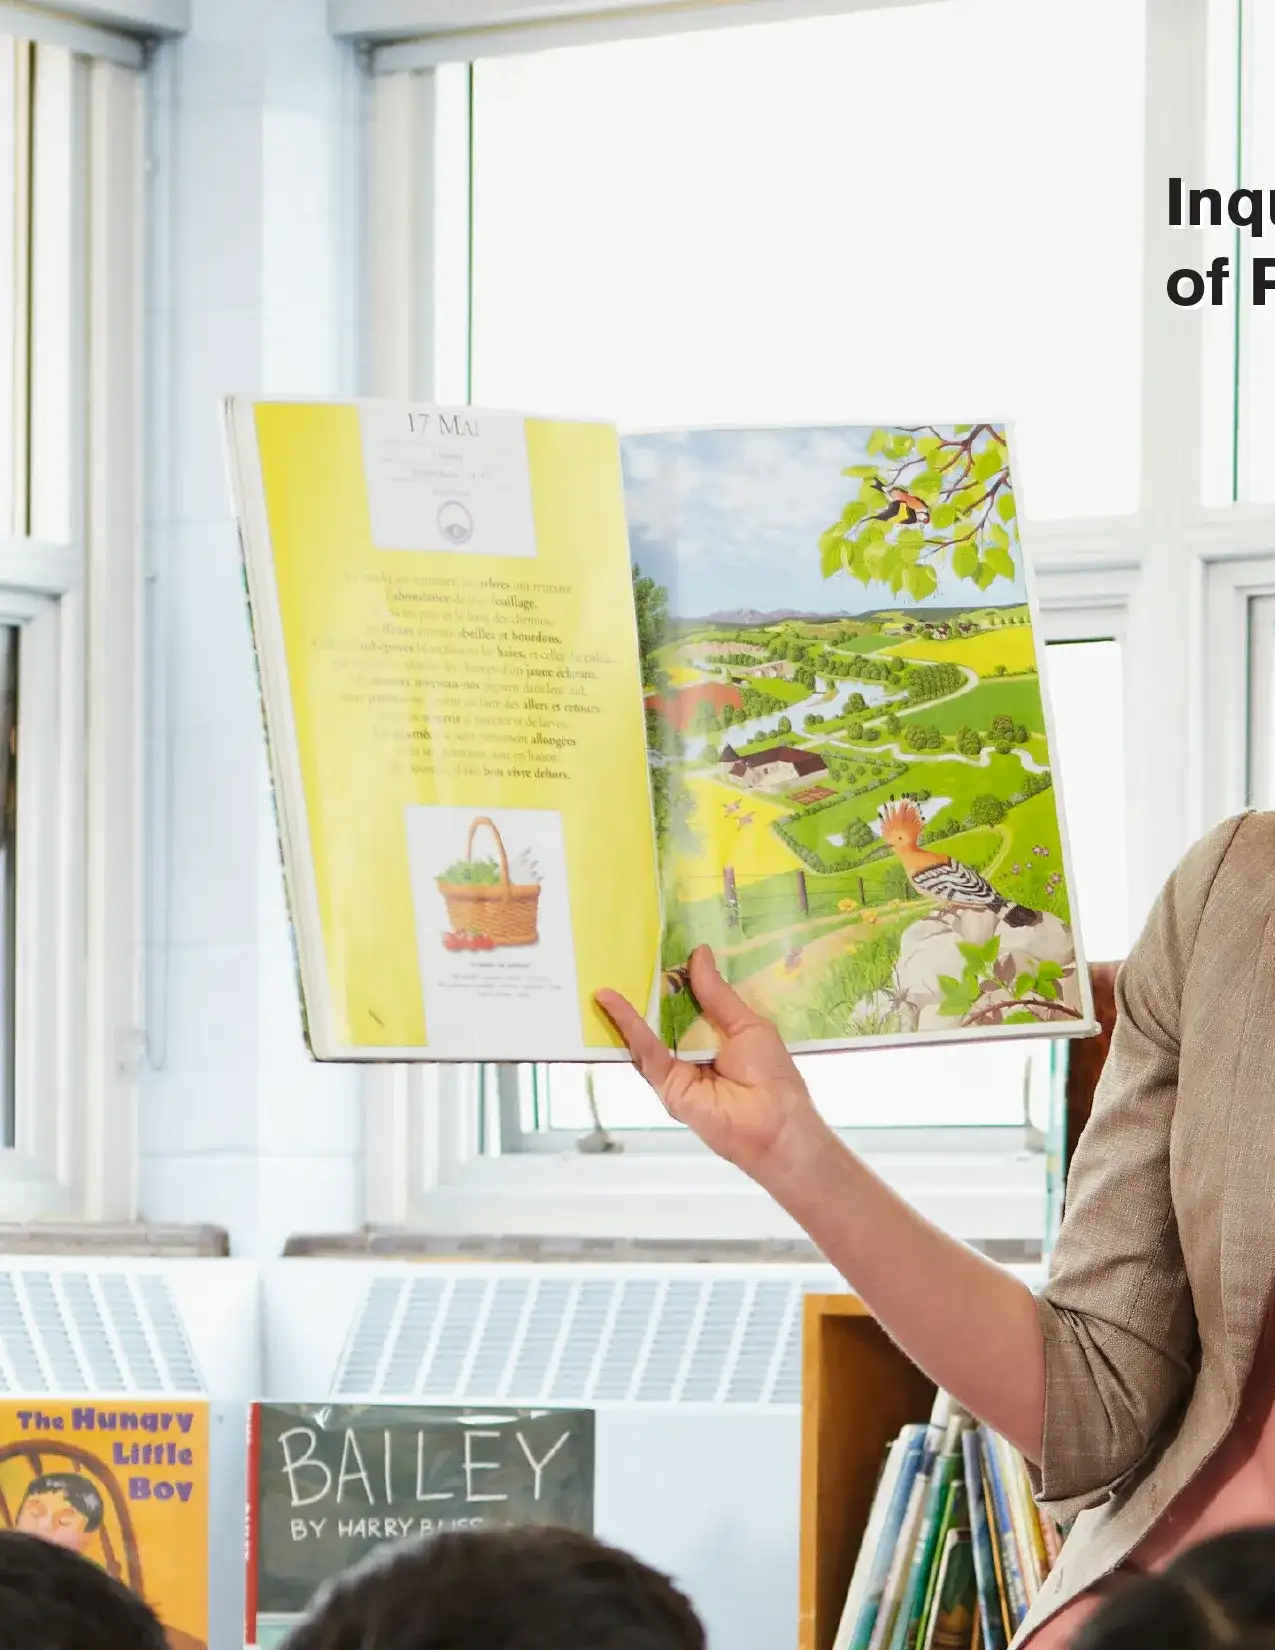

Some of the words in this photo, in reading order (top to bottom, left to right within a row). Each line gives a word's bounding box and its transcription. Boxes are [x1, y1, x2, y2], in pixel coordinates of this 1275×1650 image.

[408, 413, 430, 433] 17
[17, 1410, 65, 1432] The
[71, 1407, 195, 1433] Hungry
[112, 1443, 194, 1466] Little
[278, 1426, 571, 1508] BAILEY
[128, 1477, 194, 1502] Boy
[290, 1517, 328, 1542] BY
[338, 1517, 414, 1540] HARRY
